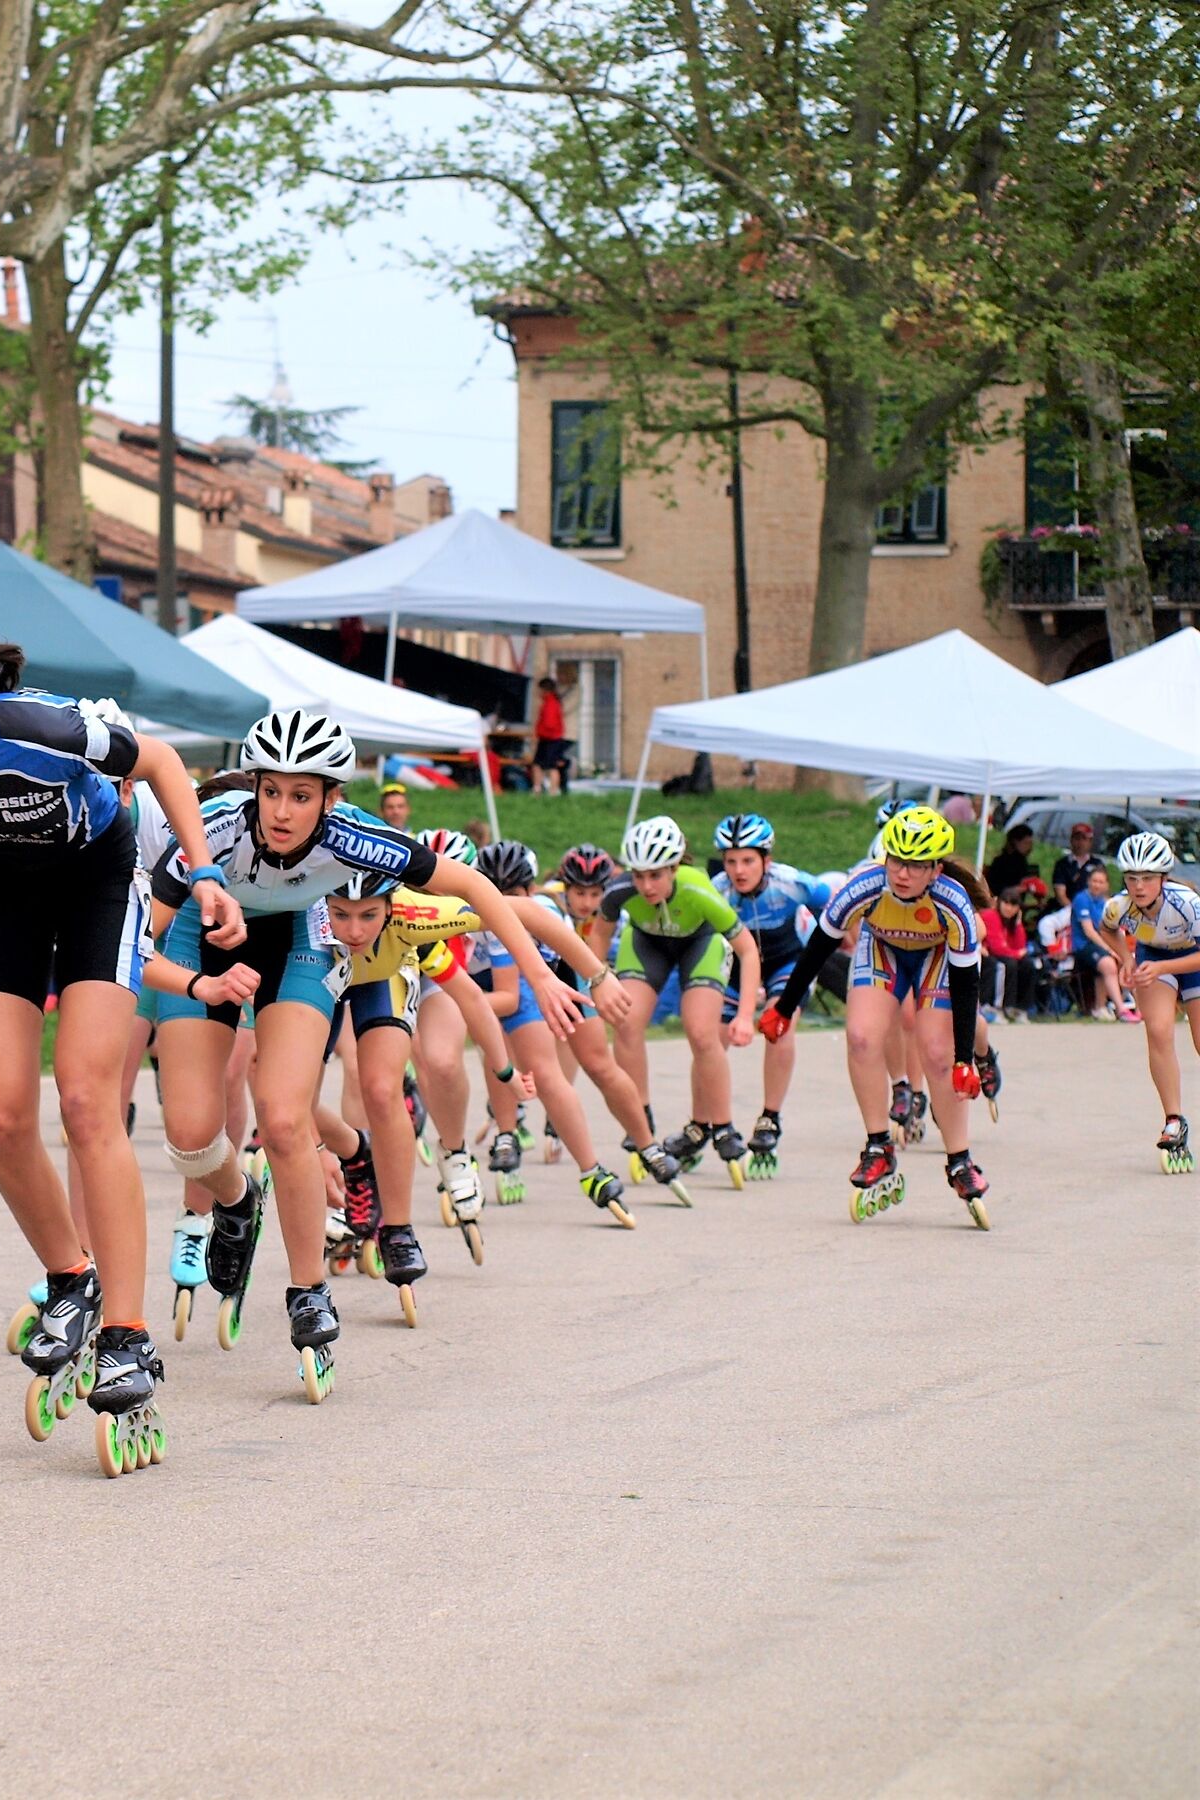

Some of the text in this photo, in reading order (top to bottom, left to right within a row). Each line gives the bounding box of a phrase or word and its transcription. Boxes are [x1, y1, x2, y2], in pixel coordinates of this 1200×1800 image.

[1, 797, 63, 824] Ravenna
[327, 826, 406, 869] TAUMAT
[407, 920, 467, 931] Rossetto
